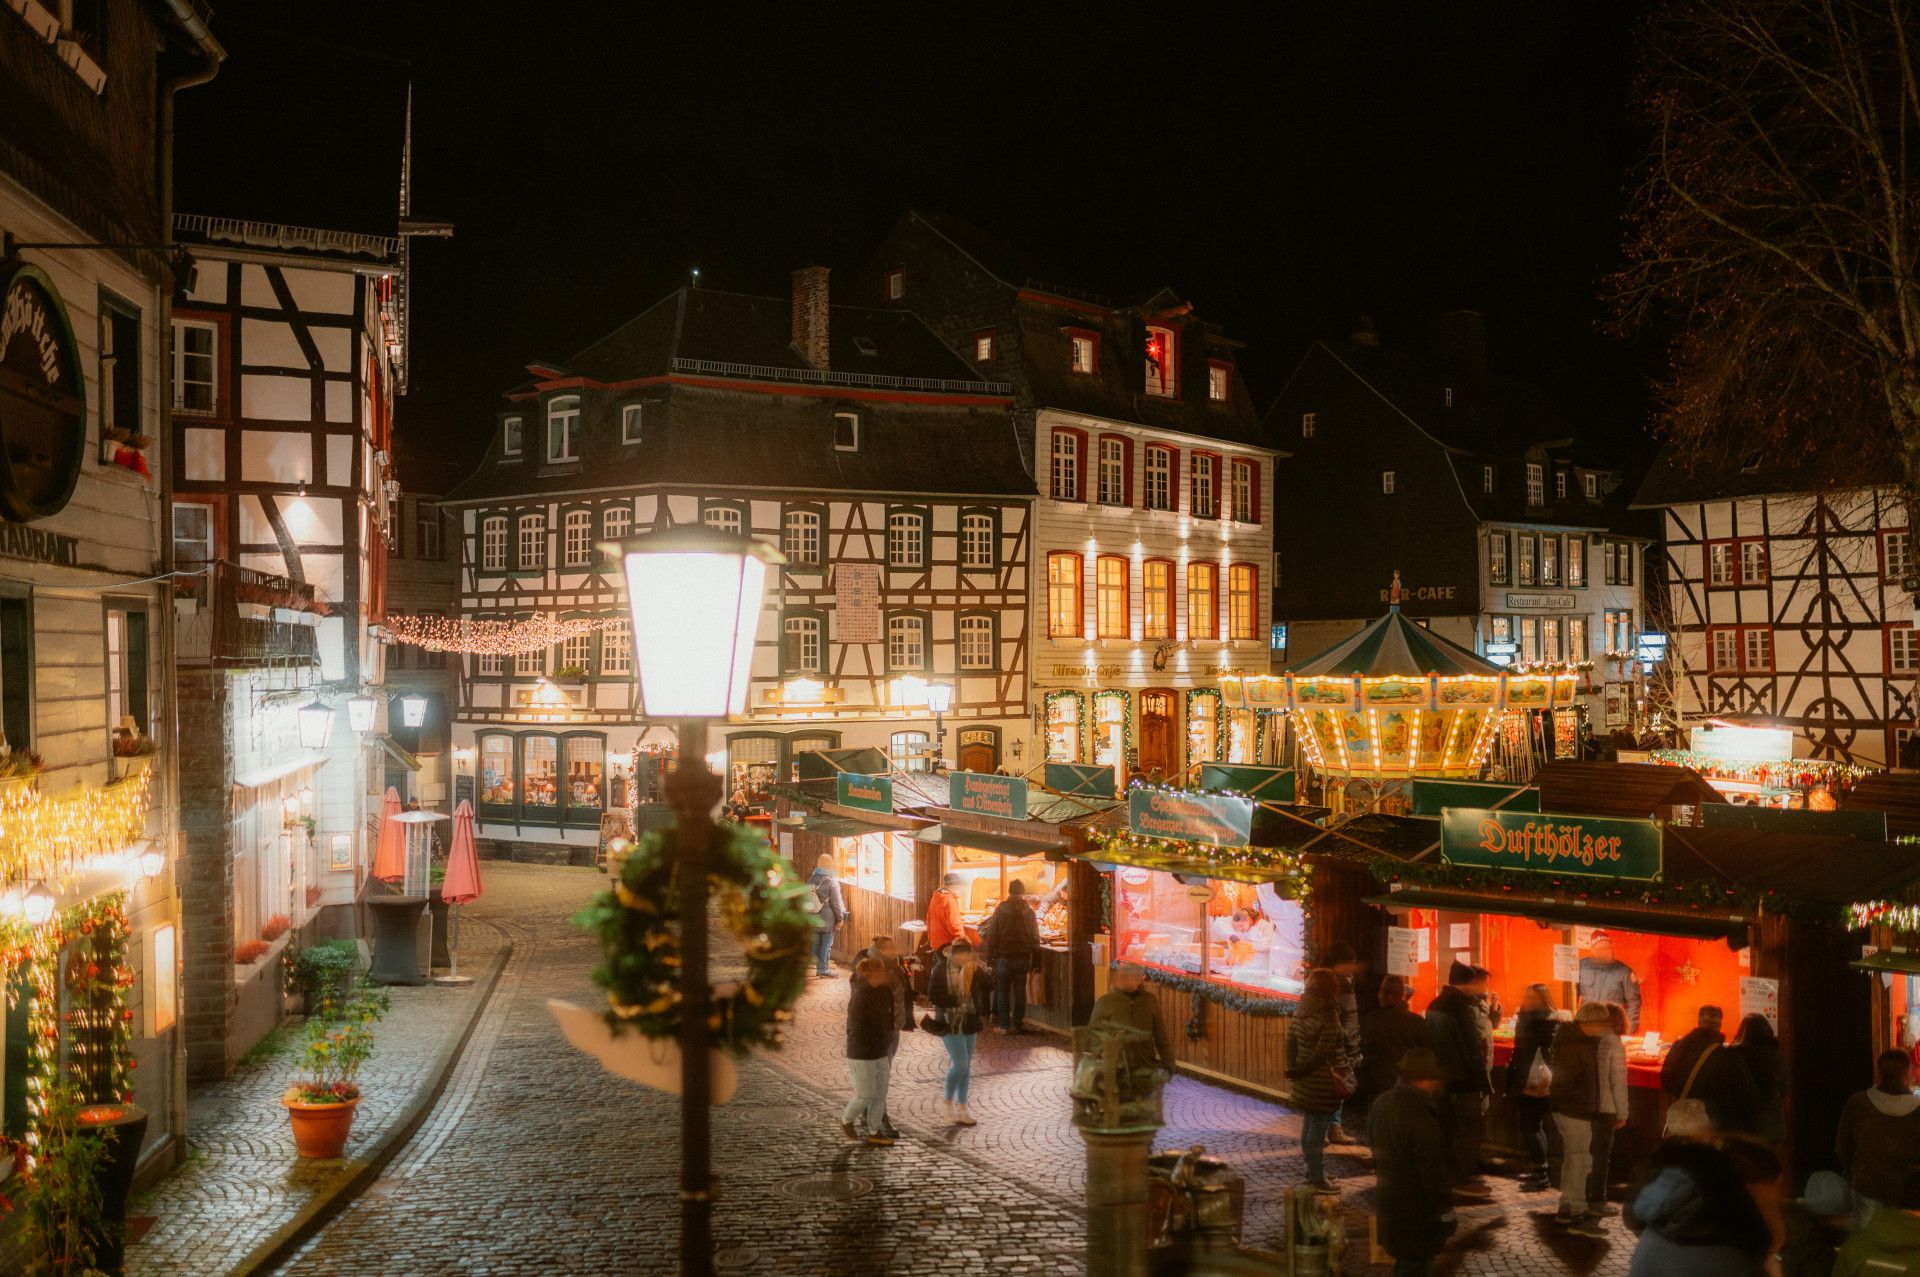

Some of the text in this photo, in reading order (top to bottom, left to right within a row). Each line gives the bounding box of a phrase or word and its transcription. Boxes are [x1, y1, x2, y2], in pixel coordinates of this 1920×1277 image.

[1380, 586, 1457, 602] RR-CAFE
[1508, 596, 1541, 608] Restaurant
[1477, 818, 1623, 867] Dufthölzer
